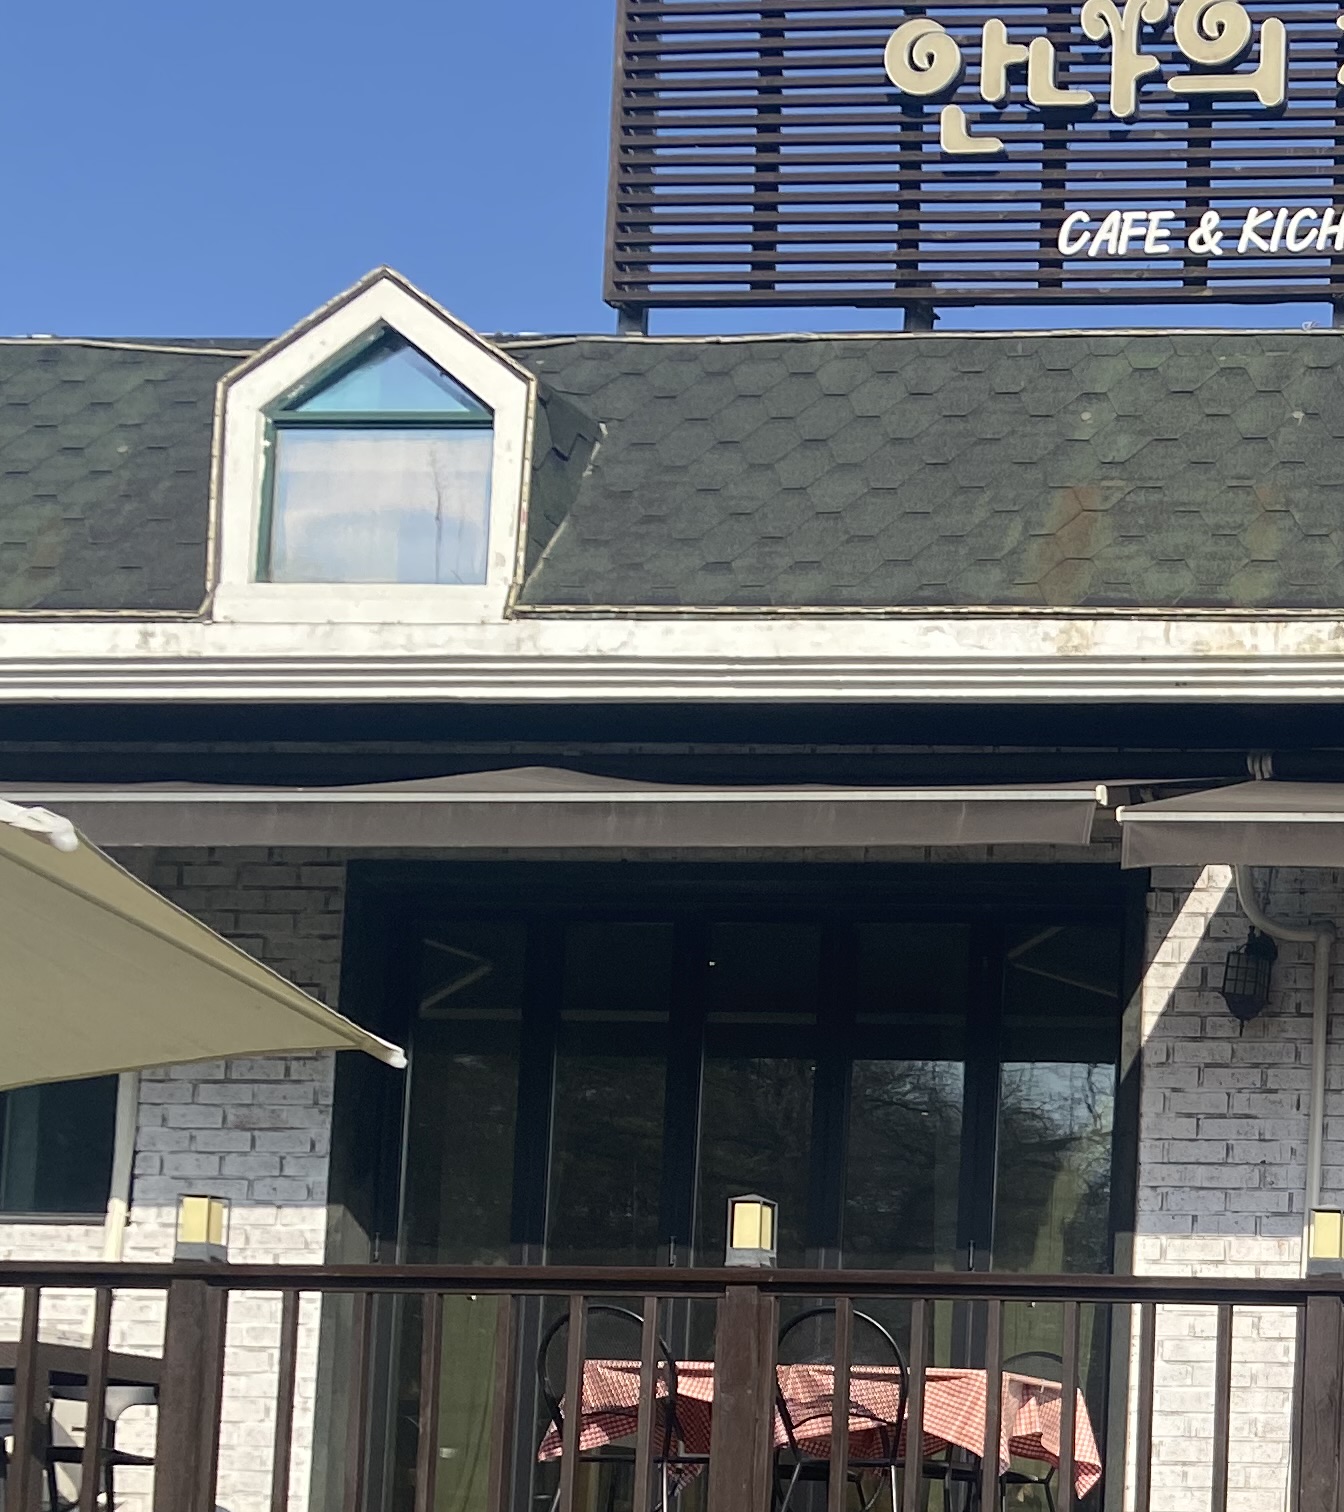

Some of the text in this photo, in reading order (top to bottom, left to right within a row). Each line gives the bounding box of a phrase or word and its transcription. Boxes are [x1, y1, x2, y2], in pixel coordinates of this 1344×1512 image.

[884, 0, 1287, 153] 안나의
[1058, 209, 1175, 257] CAFE
[1188, 210, 1224, 256] &
